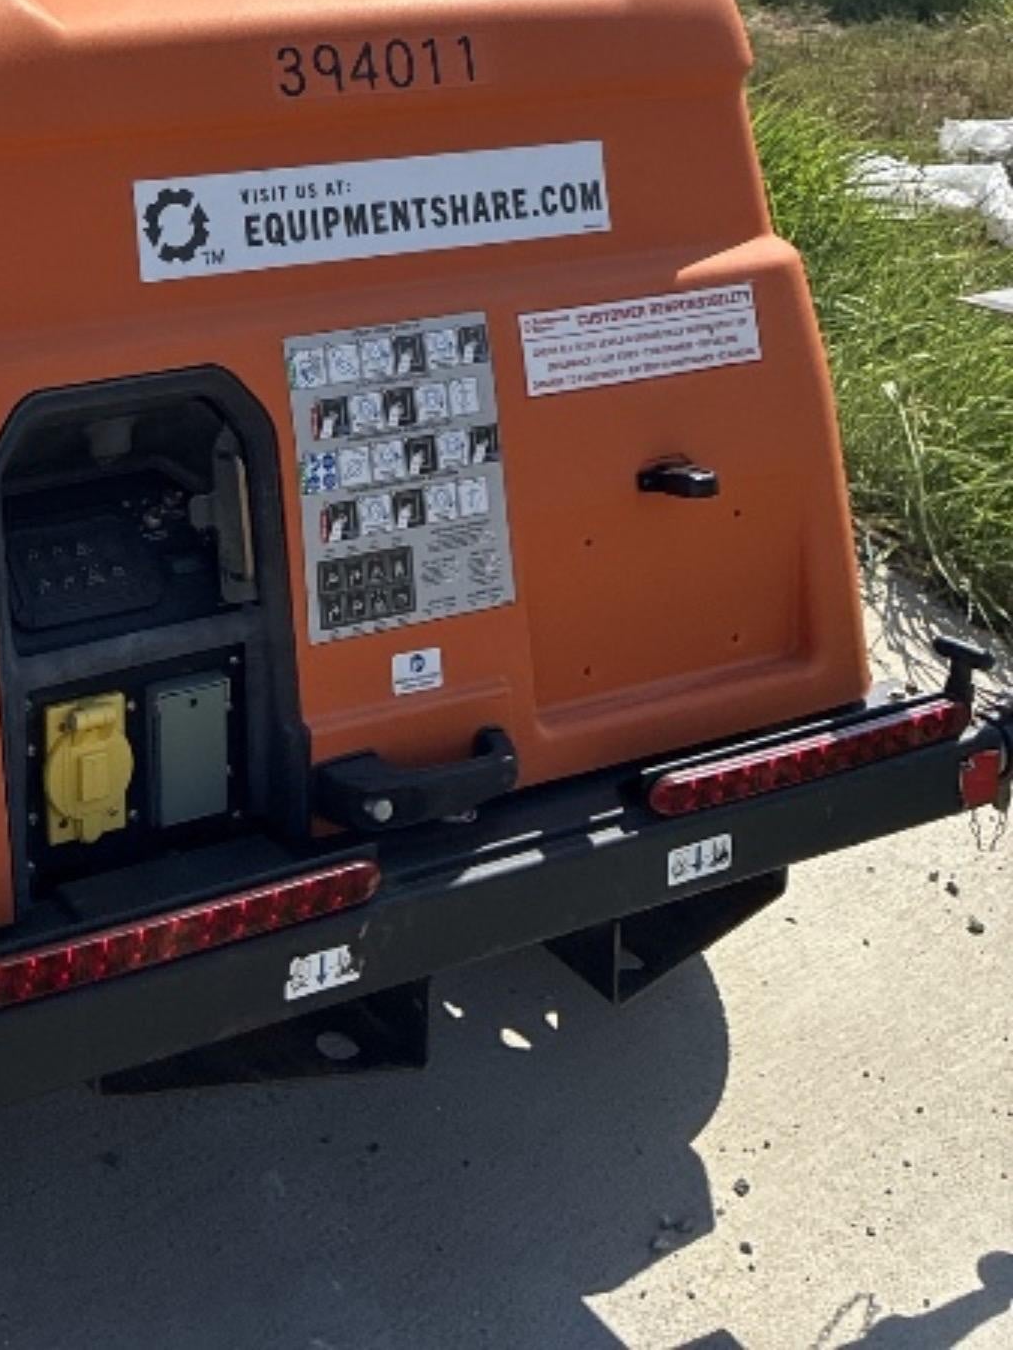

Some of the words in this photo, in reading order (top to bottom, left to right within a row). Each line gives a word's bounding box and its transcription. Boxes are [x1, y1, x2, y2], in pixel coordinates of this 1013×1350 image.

[277, 35, 477, 97] 394011
[239, 185, 288, 205] VISIT
[295, 183, 318, 201] US
[324, 179, 352, 197] AT:
[244, 179, 602, 247] EQUIPMENTSHARE.COM
